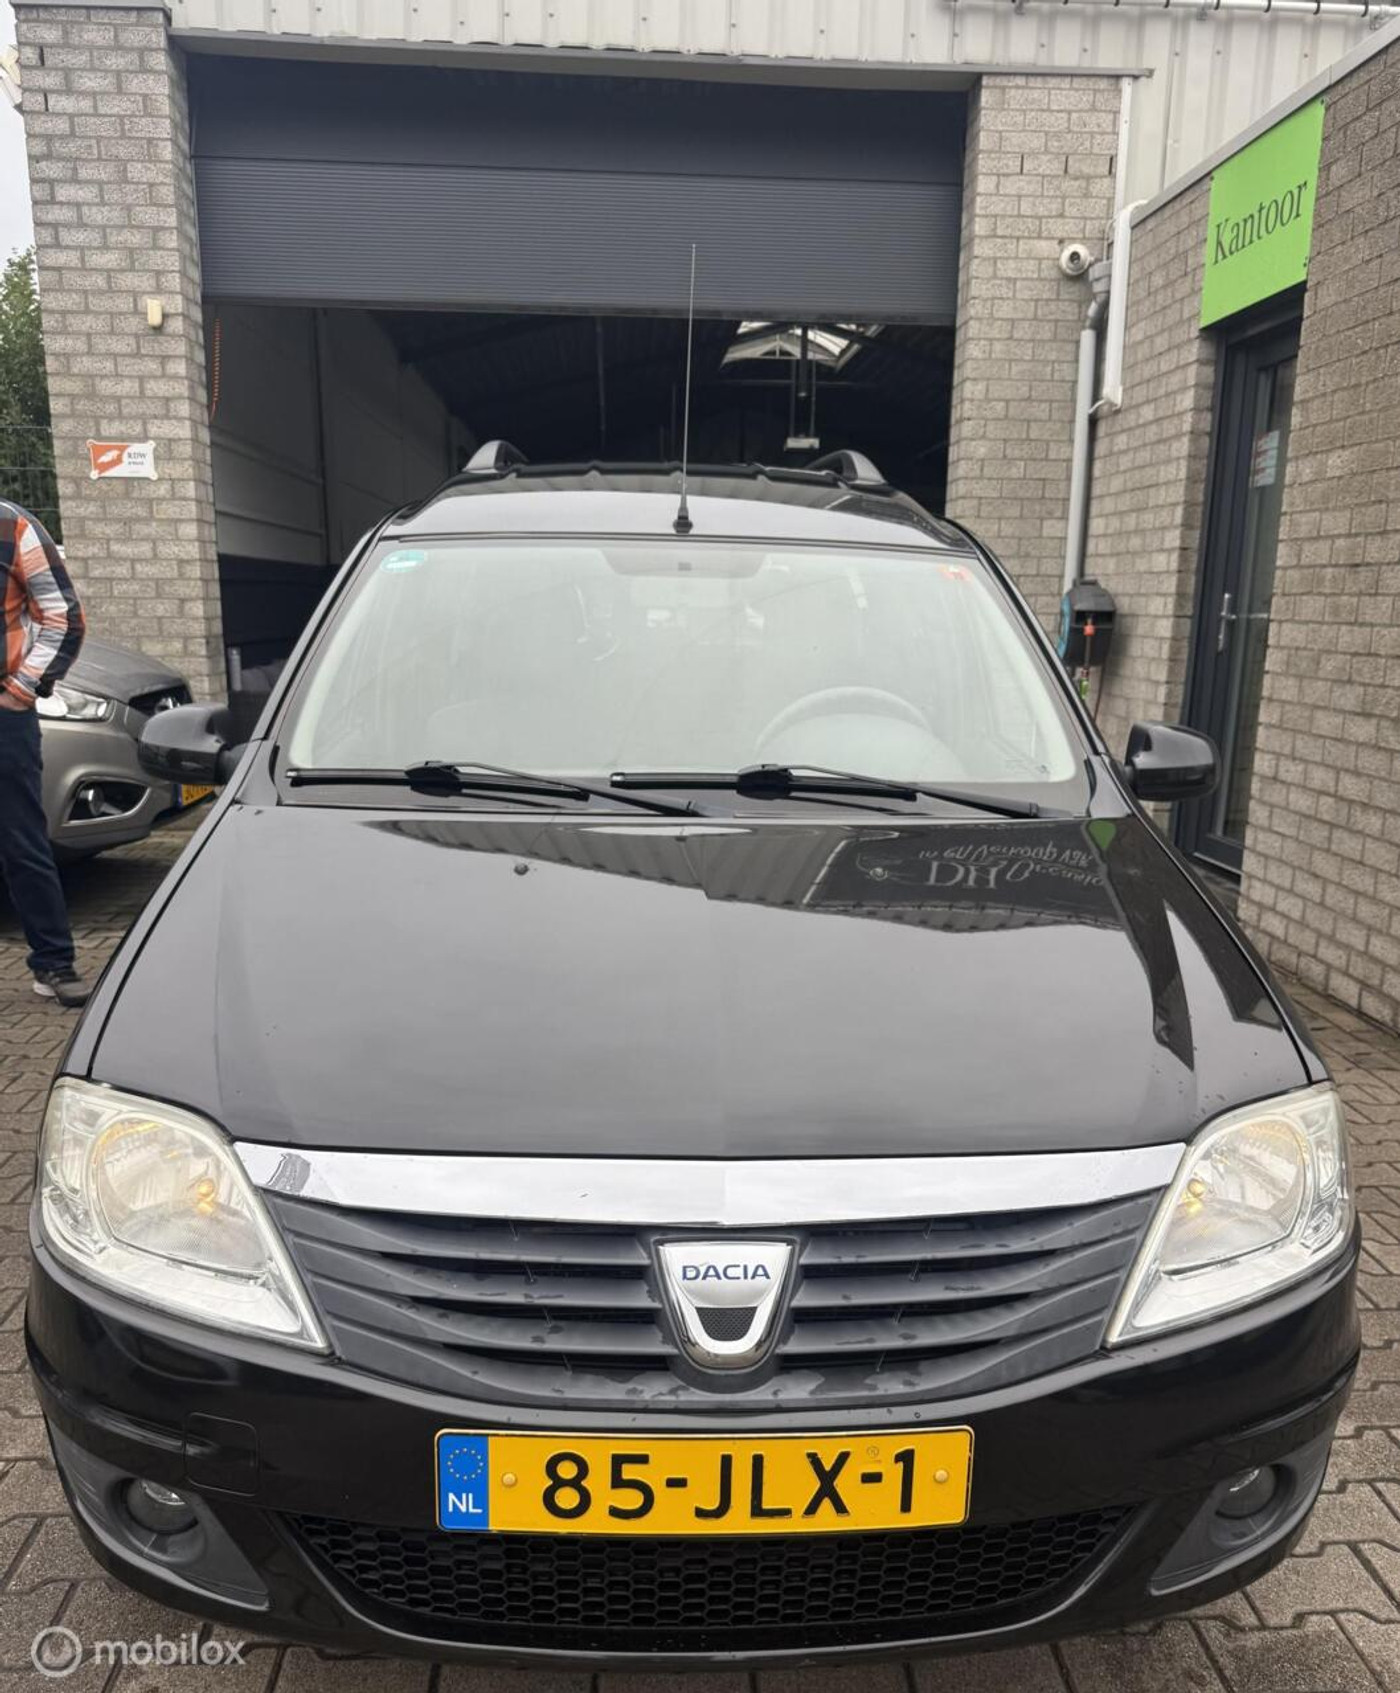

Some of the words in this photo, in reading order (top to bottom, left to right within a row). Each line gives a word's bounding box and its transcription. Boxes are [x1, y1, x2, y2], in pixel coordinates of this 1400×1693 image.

[1213, 180, 1308, 266] Kantoor
[682, 1264, 771, 1281] DACIA
[448, 1492, 482, 1514] NL
[542, 1448, 916, 1520] 85-JLX-1
